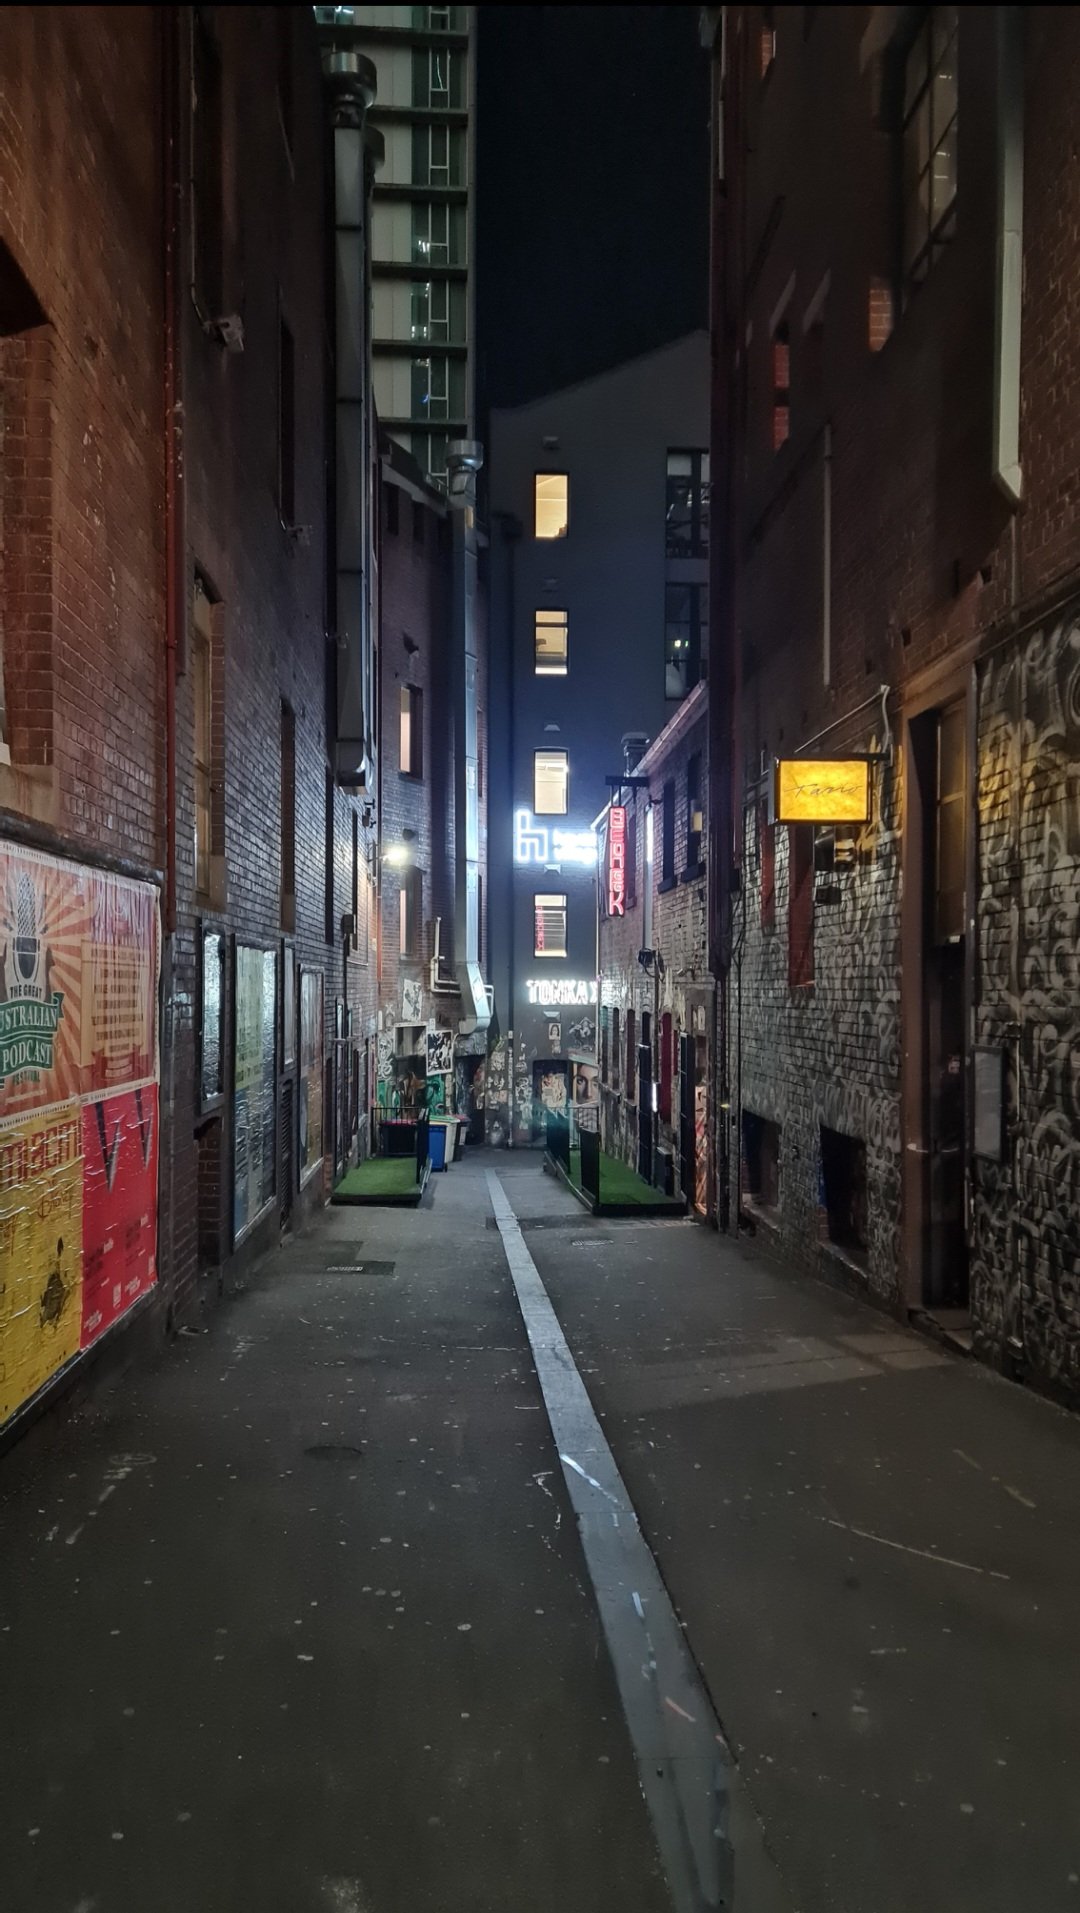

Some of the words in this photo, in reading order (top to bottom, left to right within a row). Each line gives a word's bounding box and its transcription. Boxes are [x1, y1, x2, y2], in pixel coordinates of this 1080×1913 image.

[10, 985, 22, 999] THE
[23, 984, 42, 998] GREAT
[2, 1039, 52, 1073] PODCAST
